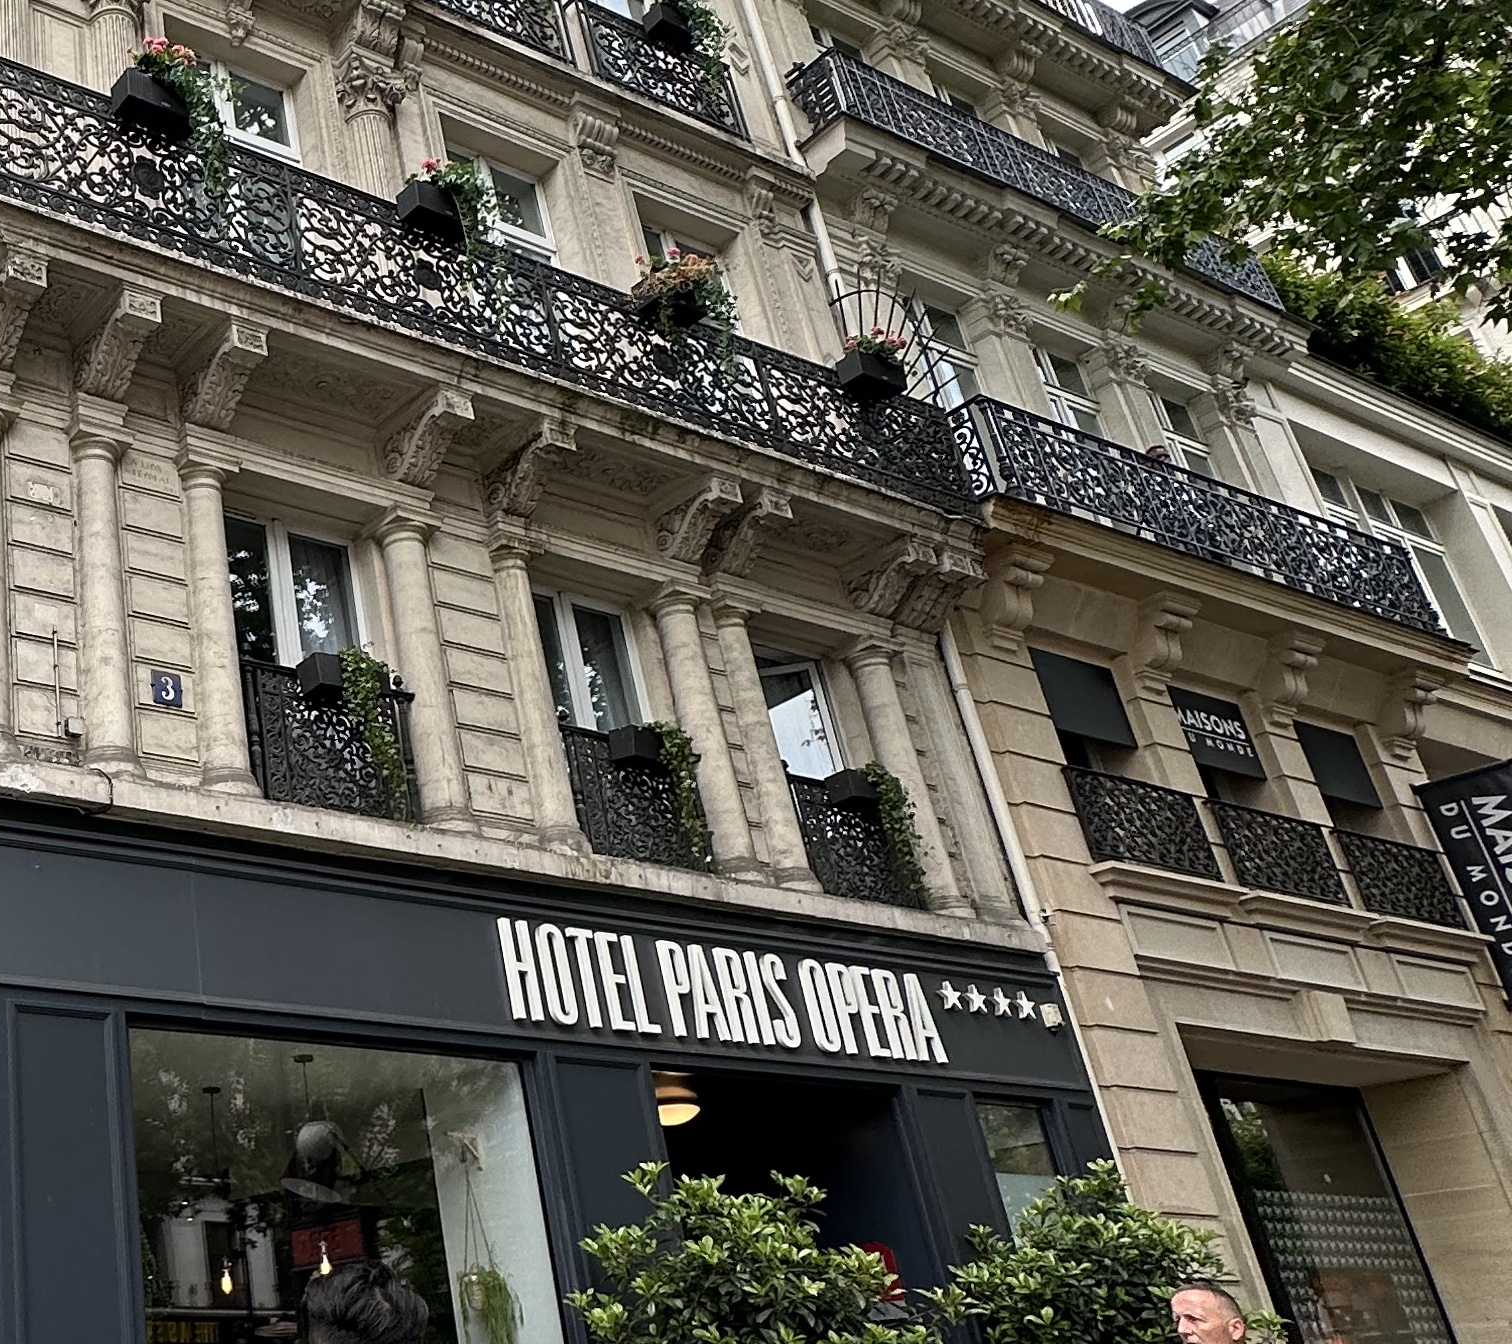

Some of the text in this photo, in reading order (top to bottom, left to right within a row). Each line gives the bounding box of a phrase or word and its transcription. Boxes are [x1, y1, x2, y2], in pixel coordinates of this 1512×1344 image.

[160, 676, 175, 701] 3
[1439, 801, 1473, 841] DU
[496, 916, 949, 1065] HOTEL PARIS OPERA
